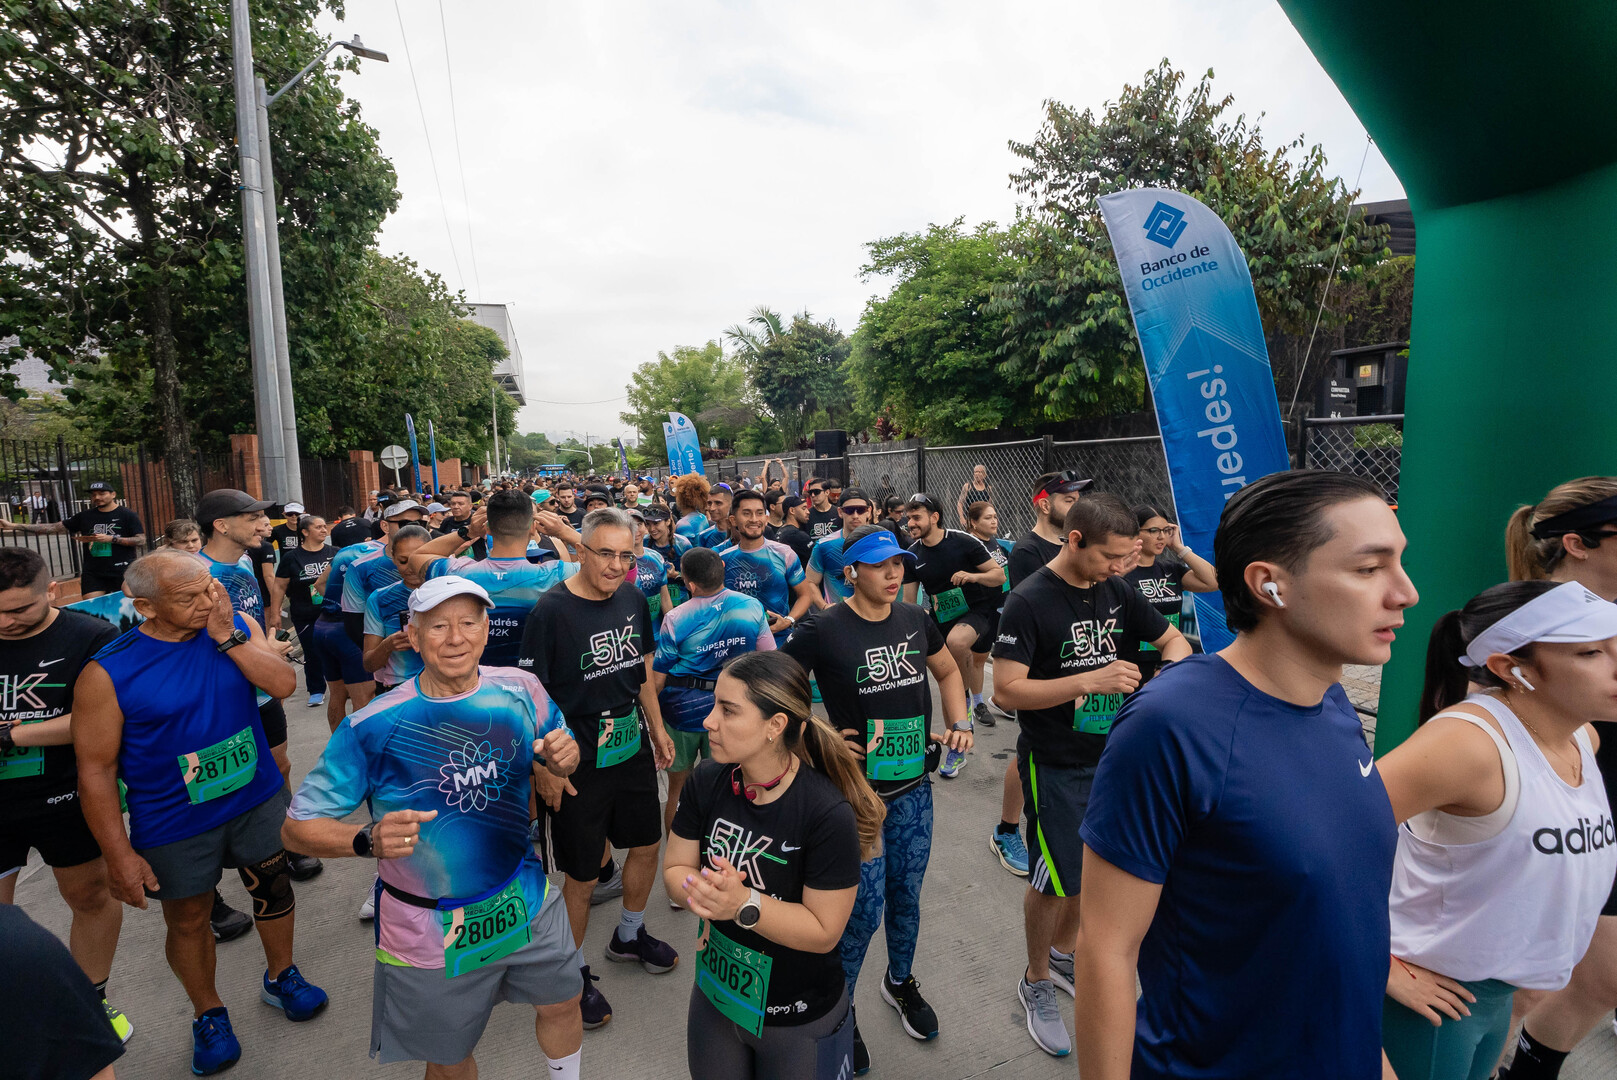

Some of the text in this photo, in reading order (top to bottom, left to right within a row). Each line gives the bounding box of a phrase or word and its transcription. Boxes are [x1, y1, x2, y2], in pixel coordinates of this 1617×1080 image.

[1140, 245, 1210, 275] Banco de
[1142, 260, 1218, 291] Occidente
[640, 573, 655, 581] MM
[739, 580, 757, 588] MM
[1138, 578, 1177, 598] 5K
[243, 594, 258, 610] MM
[936, 596, 961, 612] 26529
[488, 628, 509, 637] 42K
[1070, 618, 1117, 657] 5K
[589, 625, 639, 666] 5K
[696, 636, 746, 653] SÚPER PIPE
[714, 648, 730, 659] 10K
[583, 664, 619, 682] MARATÓN
[865, 642, 918, 682] 5K
[0, 673, 49, 711] K
[858, 673, 925, 695] MARATÓN MEDELLÍN
[9, 707, 64, 721] MEDELLÍN
[1082, 693, 1120, 713] 25789
[605, 720, 637, 749] 28160
[875, 733, 920, 757] 25336
[192, 745, 250, 784] 28715
[453, 760, 498, 792] MM
[47, 792, 74, 804] epm
[1532, 814, 1616, 855] adida
[707, 817, 773, 890] 5K
[454, 903, 517, 950] 28063
[733, 947, 753, 965] 5K
[701, 938, 754, 999] 28062
[766, 1005, 790, 1016] epm
